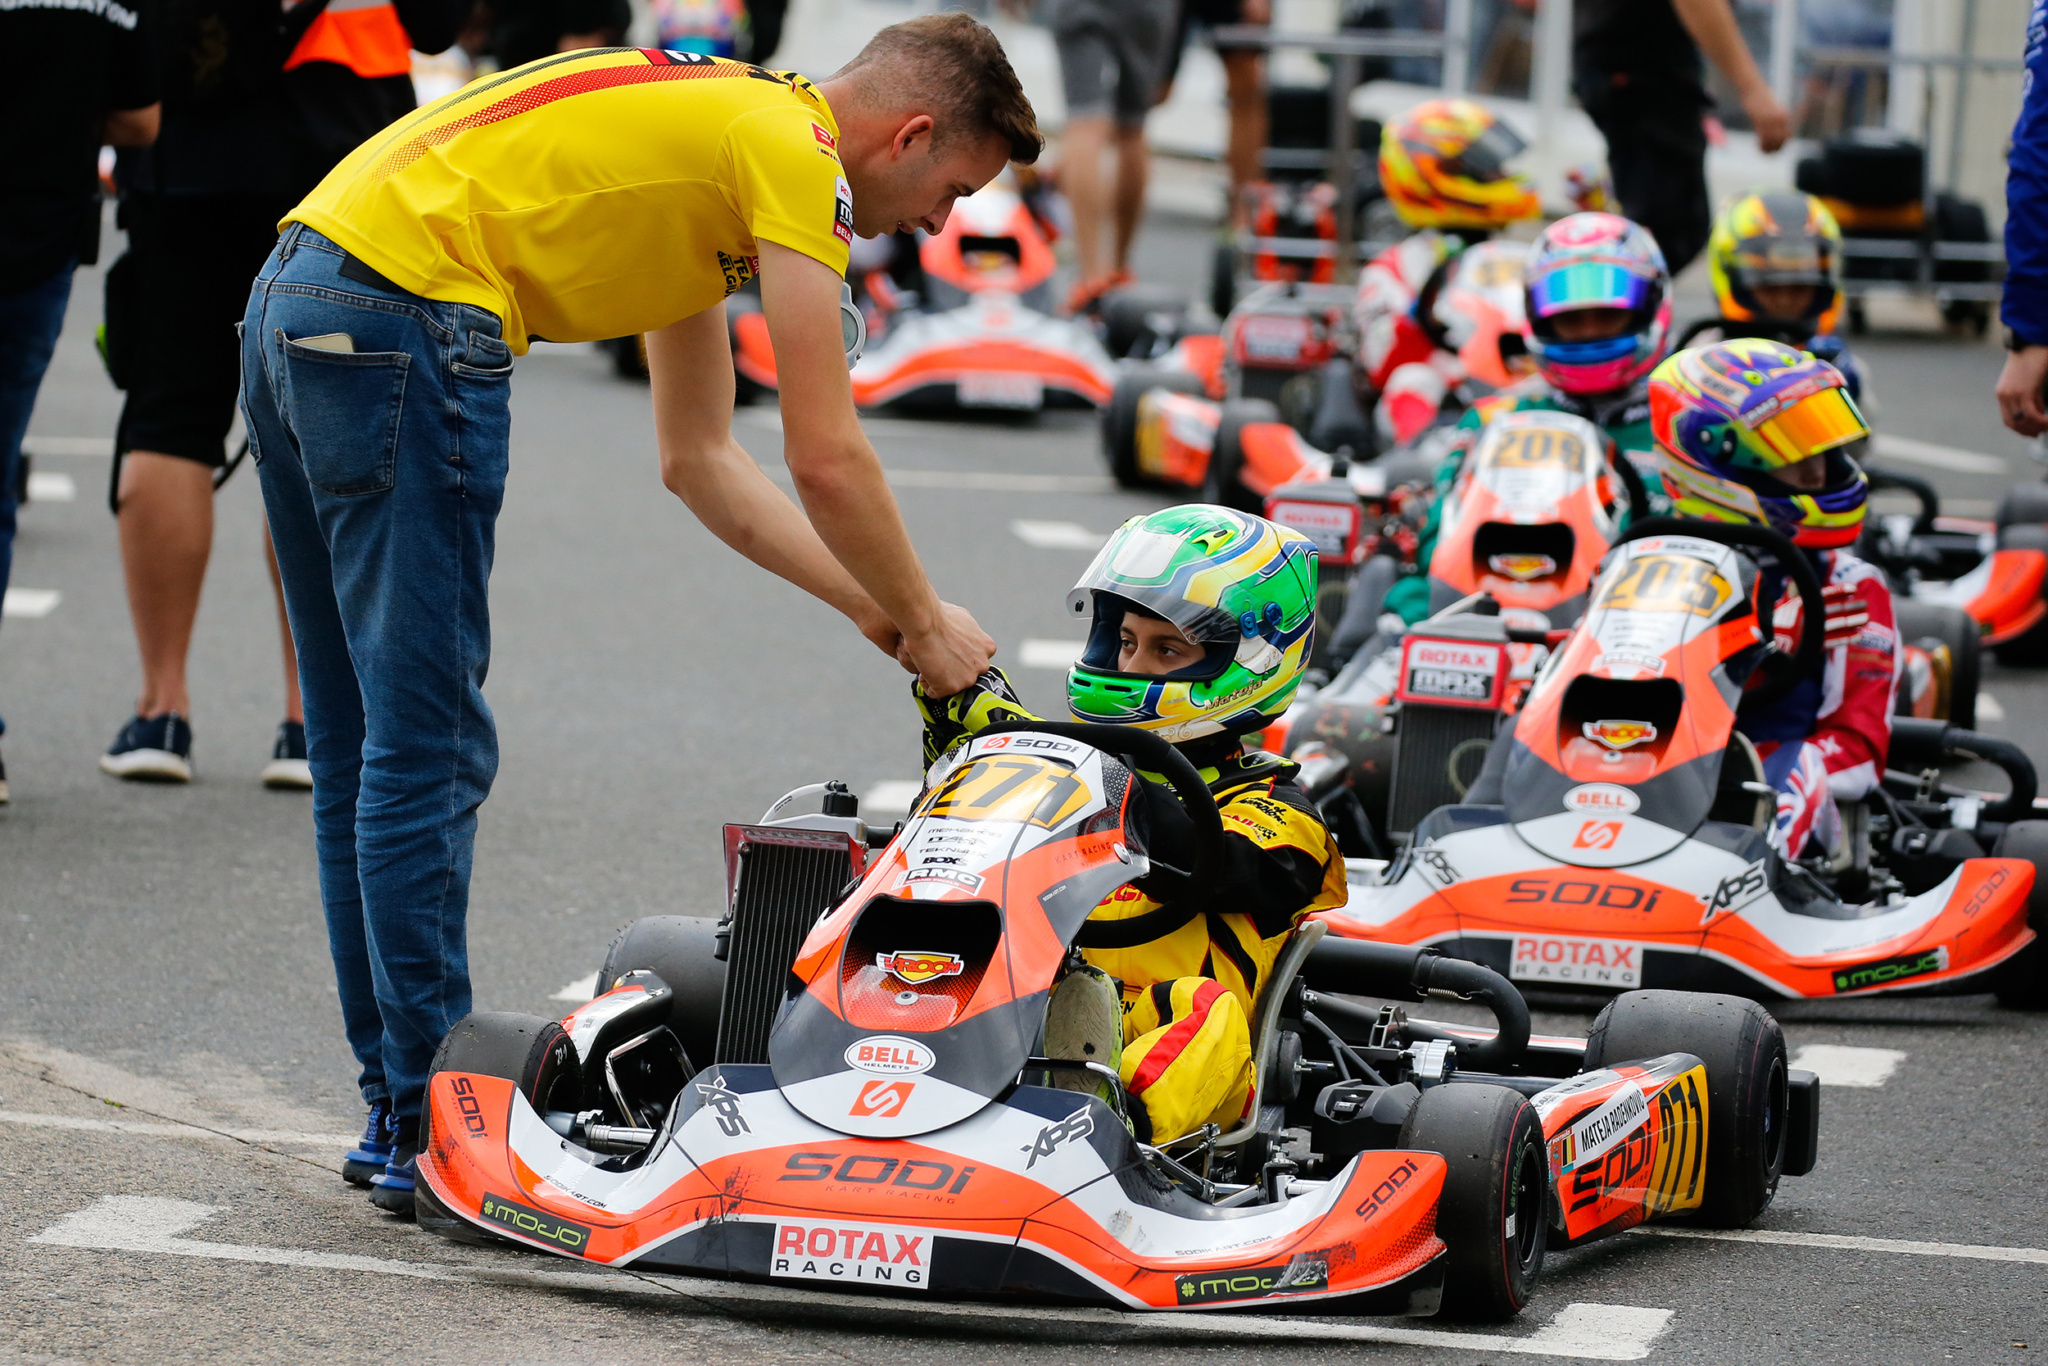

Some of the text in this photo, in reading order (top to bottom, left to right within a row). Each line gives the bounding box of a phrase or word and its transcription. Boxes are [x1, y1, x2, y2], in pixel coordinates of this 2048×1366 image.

[1419, 648, 1487, 668] ROTAX
[1203, 679, 1262, 710] Mateja
[926, 761, 1081, 825] 271
[1577, 792, 1627, 807] BELL
[1082, 842, 1111, 856] RACING
[907, 868, 978, 886] RMC
[1517, 938, 1636, 970] ROTAX
[884, 956, 961, 974] VROOM
[1515, 965, 1635, 983] RACING
[858, 1046, 919, 1066] BELL
[864, 1062, 910, 1070] HELMETS
[698, 1079, 752, 1137] XPS
[1580, 1114, 1611, 1152] MATEJA
[1609, 1088, 1645, 1134] RADENKOVIC
[1019, 1106, 1093, 1171] XPS
[825, 1184, 956, 1205] KART RACING
[777, 1225, 924, 1267] ROTAX
[1175, 1235, 1273, 1257] SODIKART.COM
[775, 1259, 921, 1283] RACING
